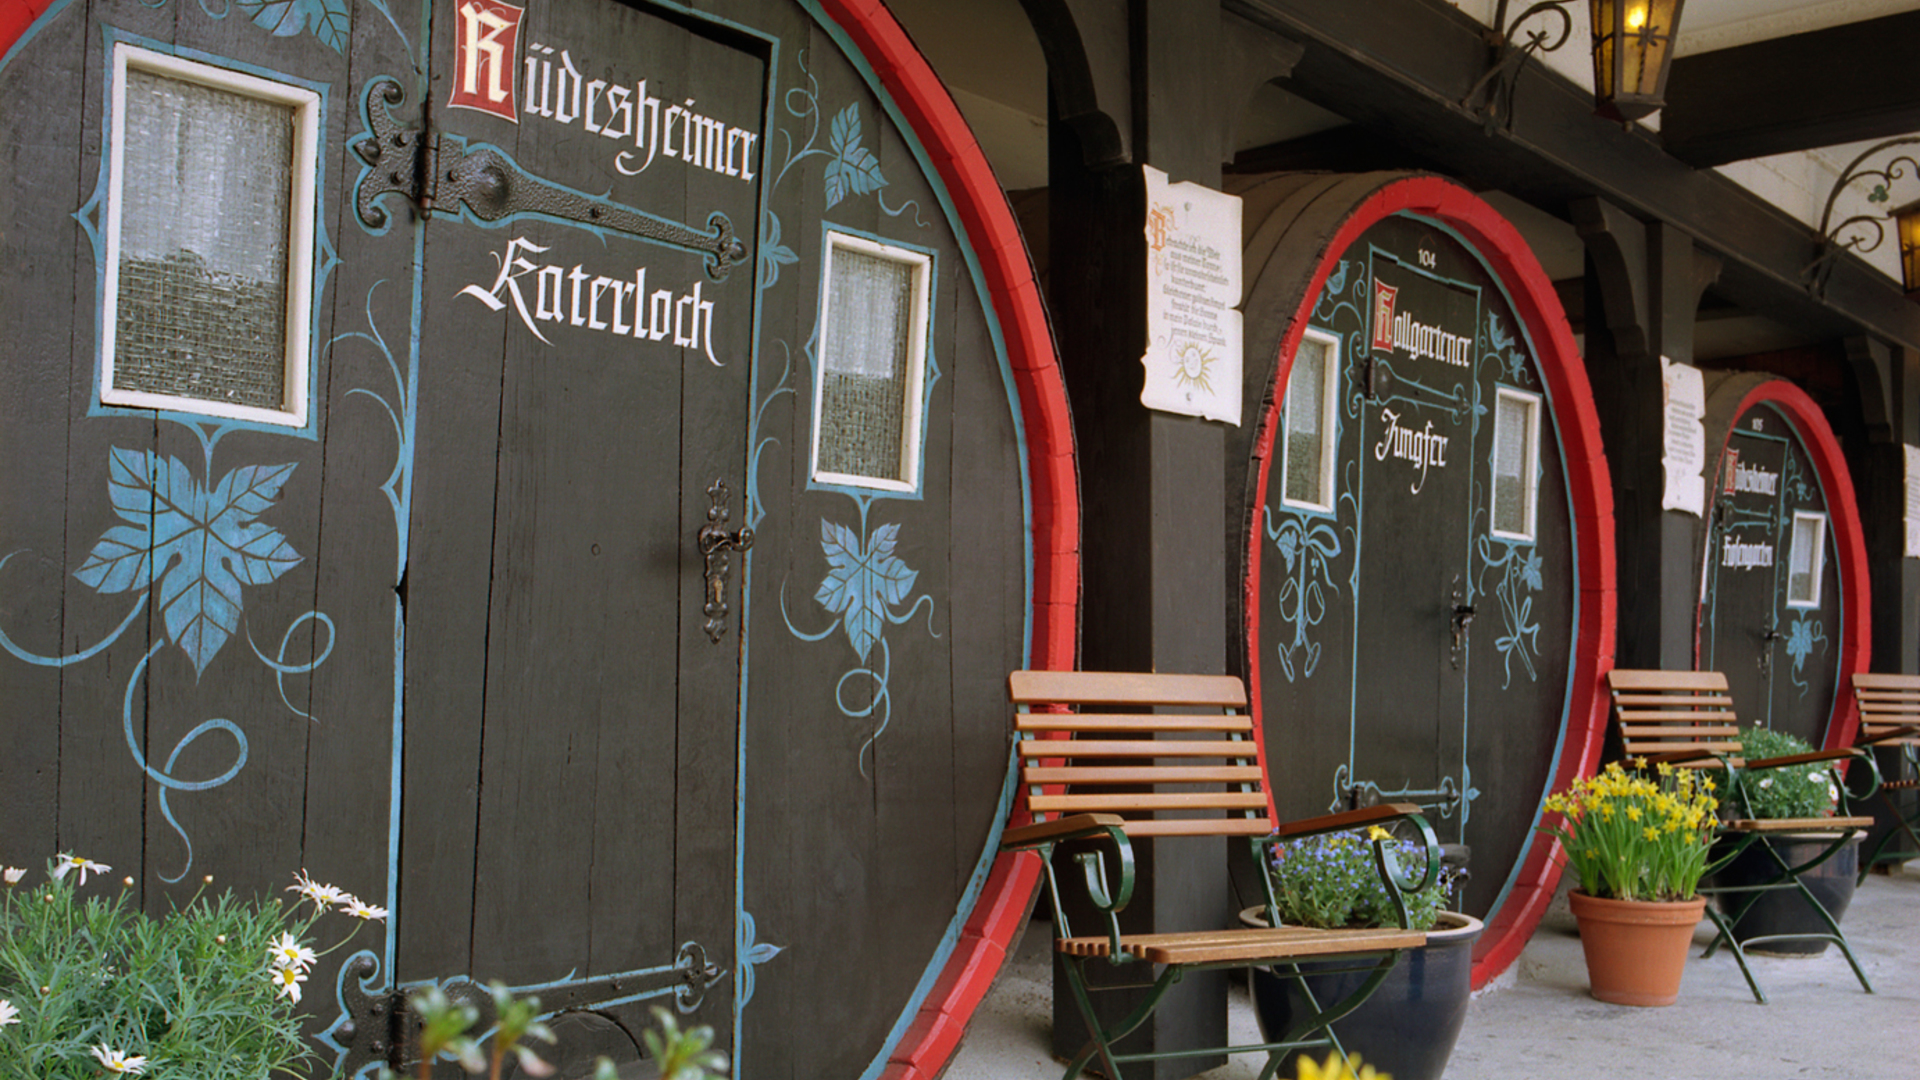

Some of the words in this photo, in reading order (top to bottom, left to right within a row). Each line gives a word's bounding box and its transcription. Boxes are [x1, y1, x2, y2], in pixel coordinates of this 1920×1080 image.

[460, 1, 758, 182] Rüdesheimer
[453, 236, 726, 368] Katerloch
[1418, 248, 1436, 269] 104
[1375, 290, 1472, 368] Hallgartener
[1373, 408, 1449, 495] Jungfer
